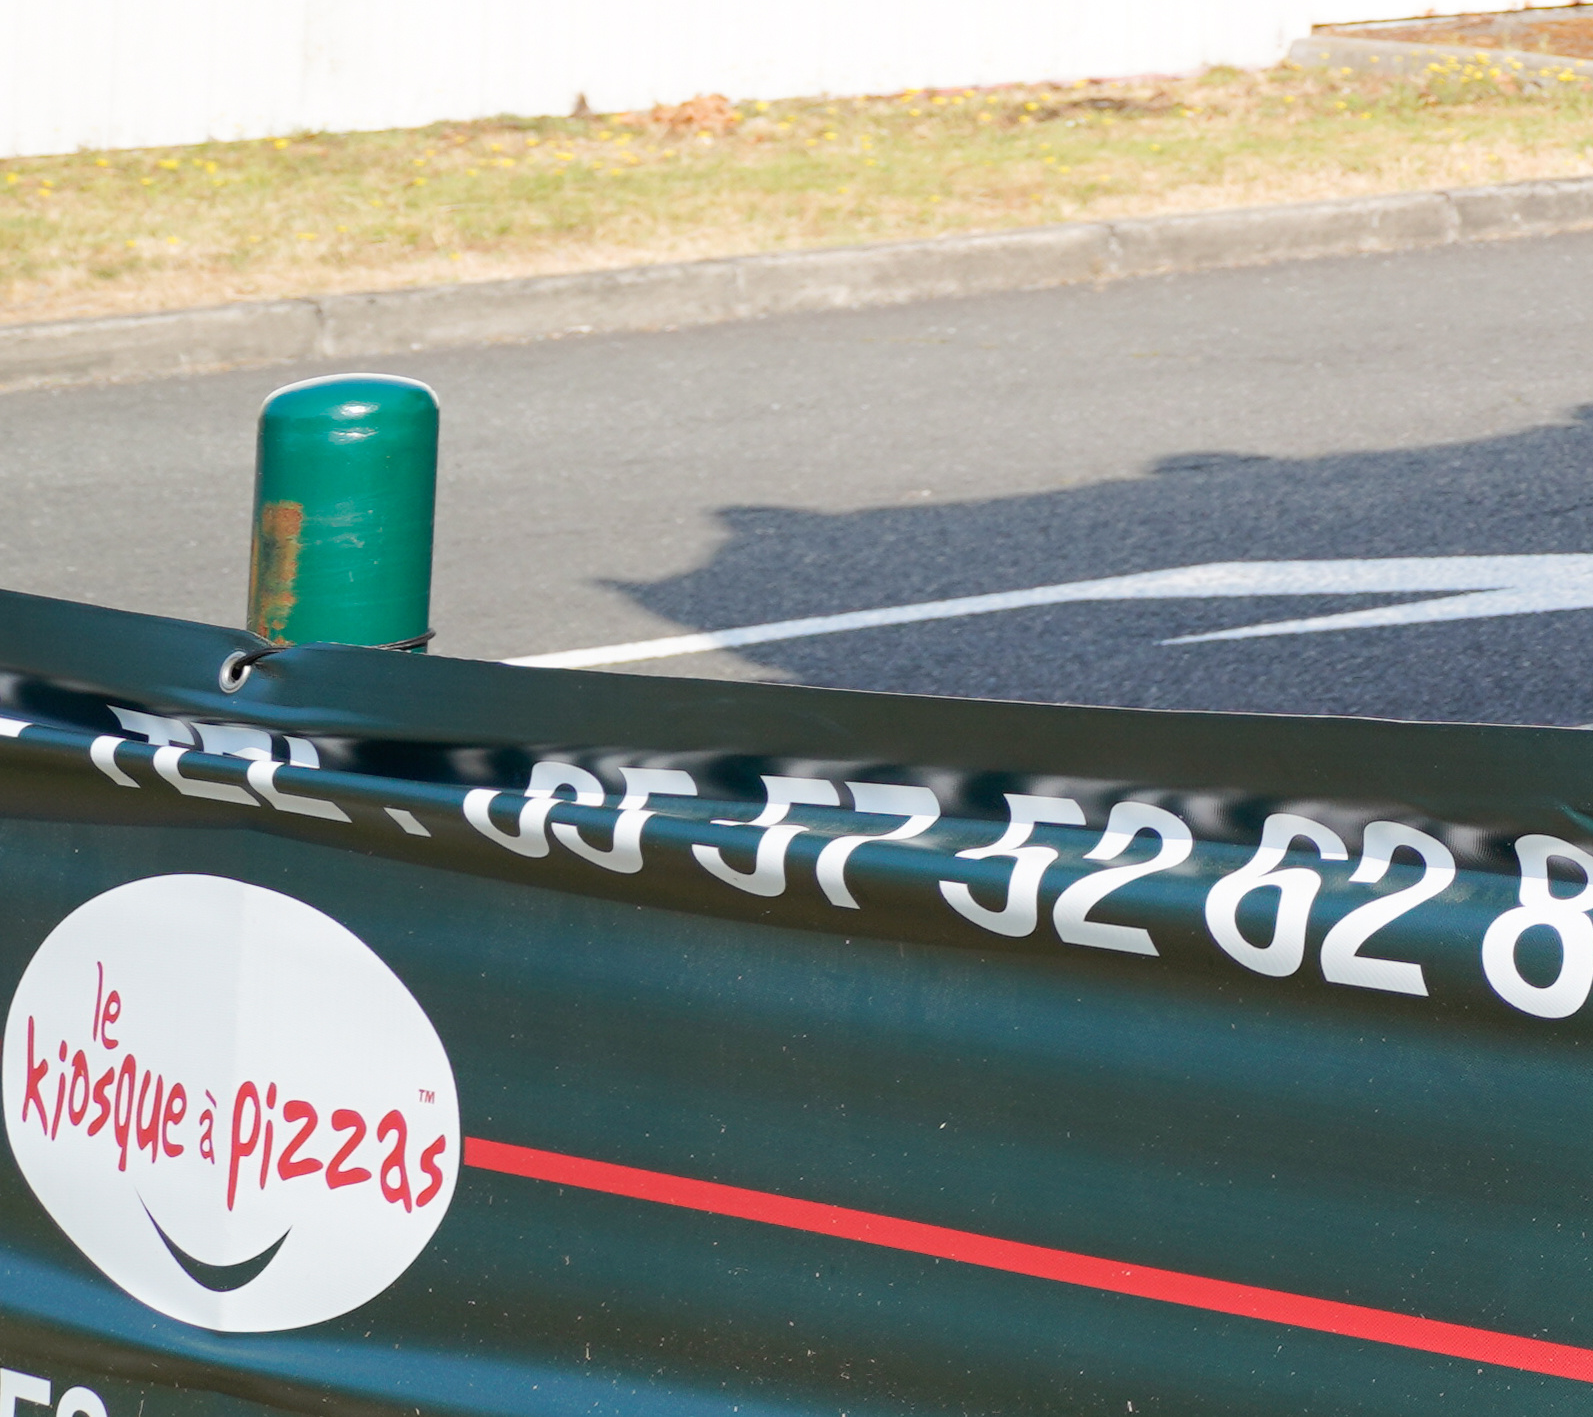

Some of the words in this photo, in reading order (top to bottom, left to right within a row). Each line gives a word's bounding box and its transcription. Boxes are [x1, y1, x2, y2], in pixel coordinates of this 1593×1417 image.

[463, 761, 698, 873] 05
[691, 774, 941, 910] 57
[939, 793, 1194, 957] 52
[1205, 813, 1456, 997] 62
[93, 961, 121, 1050] le
[21, 1015, 186, 1172] kiosque
[200, 1089, 215, 1165] à
[226, 1080, 447, 1213] pizzas
